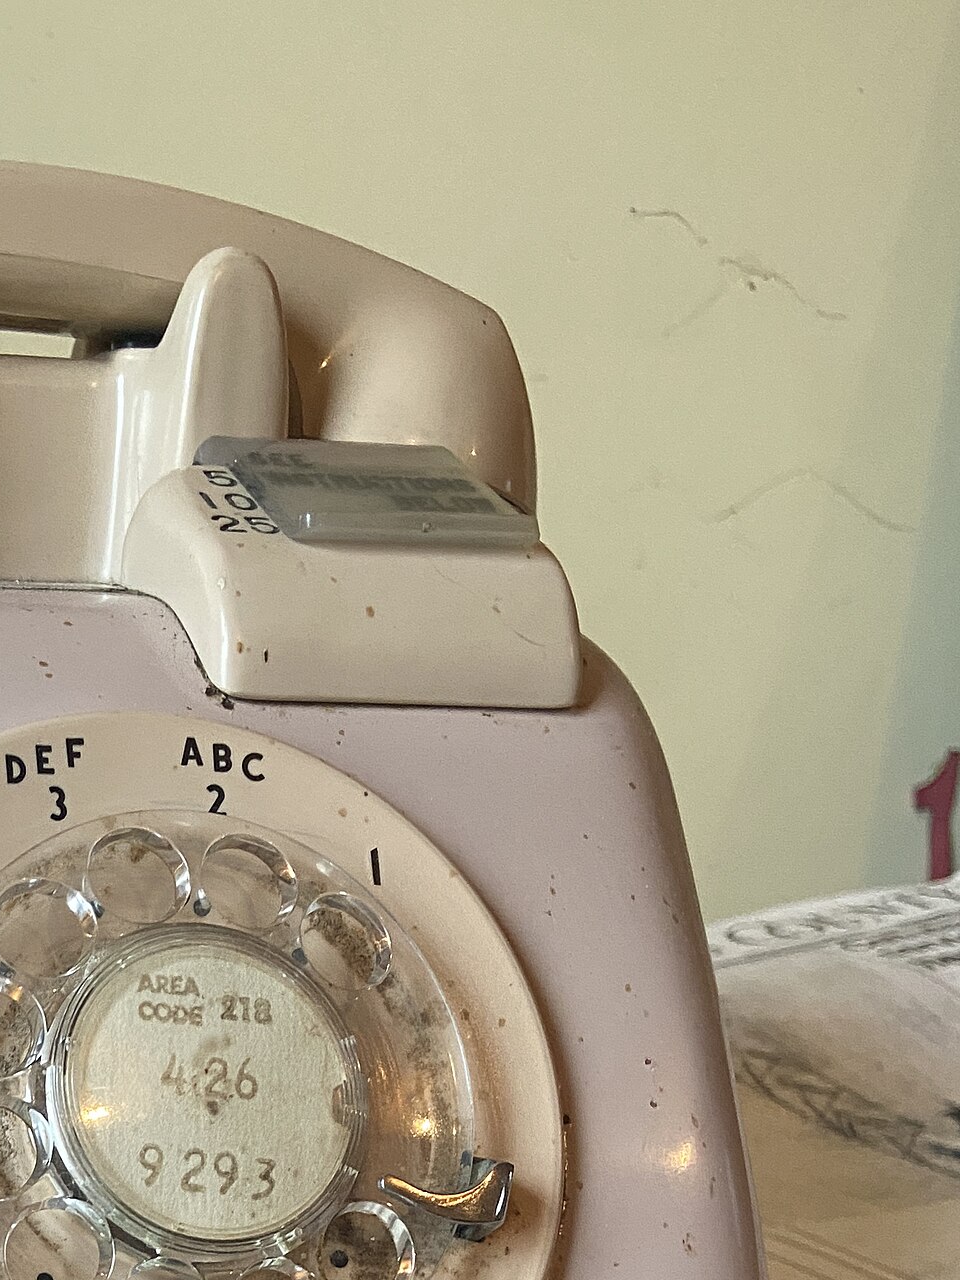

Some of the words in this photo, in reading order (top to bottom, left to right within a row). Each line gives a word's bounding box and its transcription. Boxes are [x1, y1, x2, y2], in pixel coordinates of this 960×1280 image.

[202, 469, 238, 487] 5
[199, 491, 258, 511] 10
[211, 514, 280, 534] 25
[5, 738, 84, 783] DEF
[181, 737, 265, 782] ABC
[49, 786, 68, 821] 3
[207, 784, 227, 816] 2
[370, 847, 381, 886] 1
[137, 974, 200, 996] AREA
[138, 1000, 203, 1026] CODE
[220, 995, 272, 1025] 218
[139, 1143, 276, 1200] 9293
